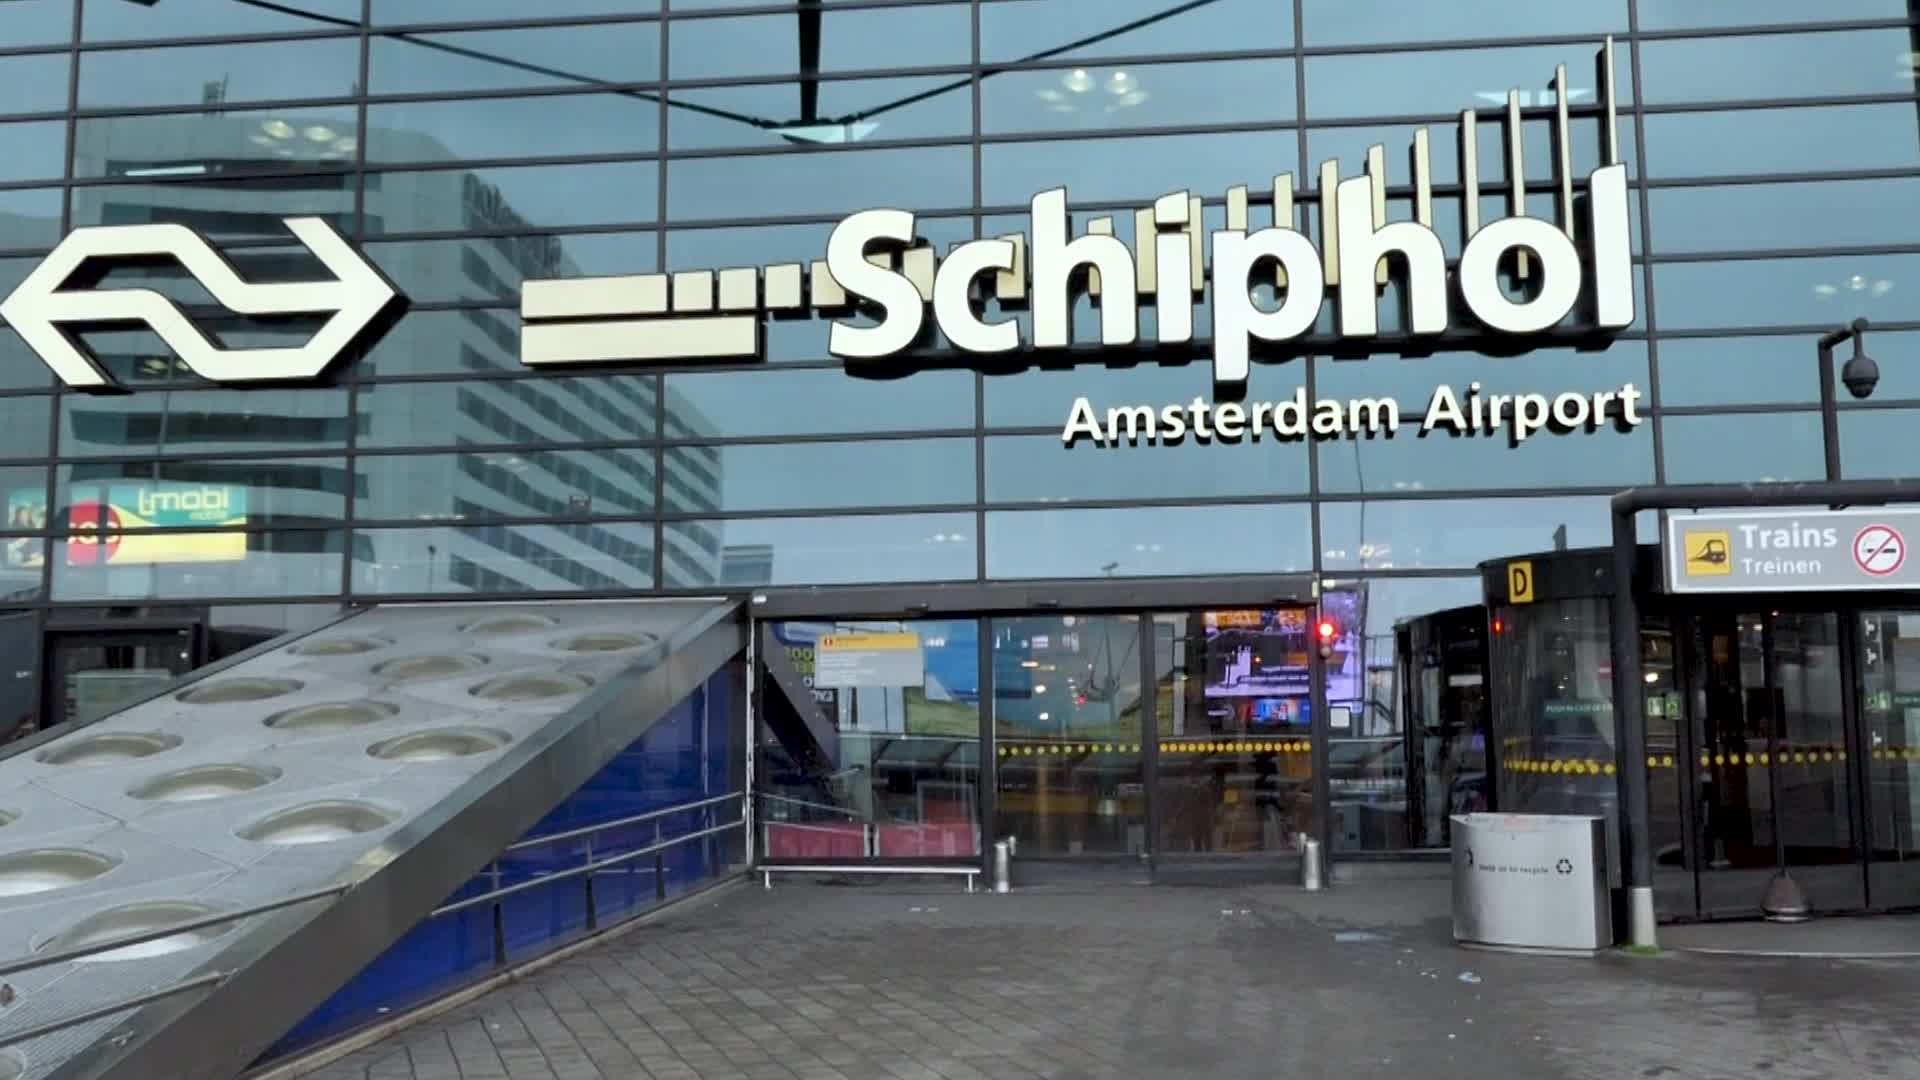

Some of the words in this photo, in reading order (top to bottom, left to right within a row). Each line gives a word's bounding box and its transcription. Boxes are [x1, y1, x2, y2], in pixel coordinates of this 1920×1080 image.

[826, 163, 1635, 381] Schiphol
[1062, 387, 1399, 443] Amsterdam
[1424, 382, 1643, 448] Airport
[1739, 522, 1838, 550] Trains
[1743, 557, 1822, 575] Treinen
[1513, 568, 1527, 597] D
